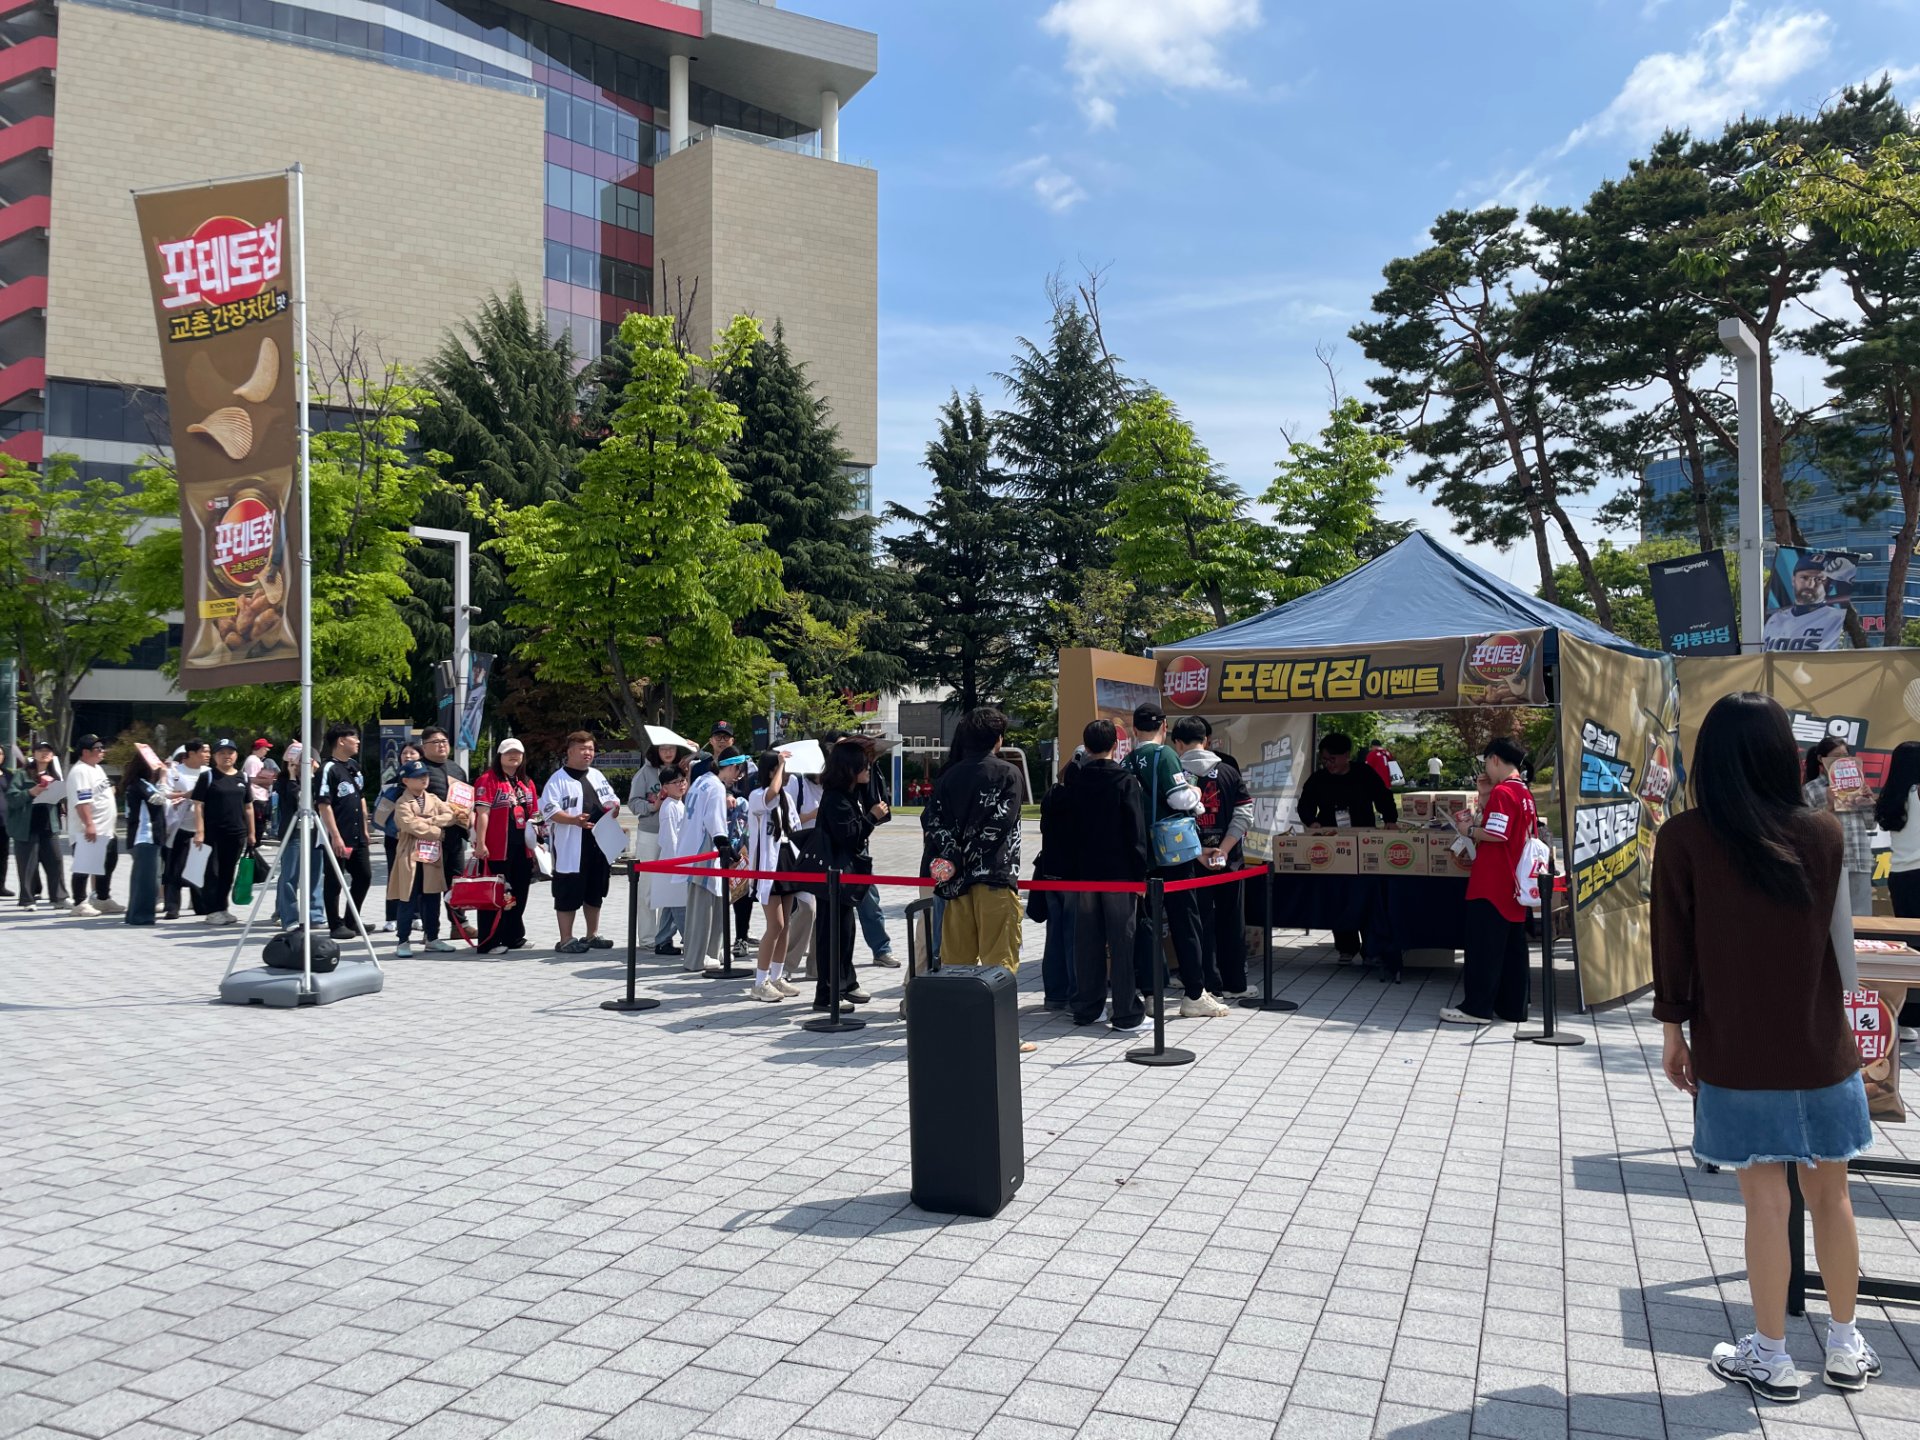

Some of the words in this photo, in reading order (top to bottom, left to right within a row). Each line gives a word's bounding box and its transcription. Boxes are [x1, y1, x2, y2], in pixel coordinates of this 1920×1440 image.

[159, 218, 282, 308] 포테토칩
[170, 310, 211, 340] 교촌
[213, 509, 276, 566] 포테토칩
[1671, 625, 1730, 650] 위풍당당
[1469, 644, 1527, 666] 포테토칩
[1163, 667, 1210, 696] 포테토칩
[1221, 659, 1366, 700] 포텐터짐
[1366, 667, 1440, 696] 이벤트
[1583, 722, 1618, 757] 오늘의
[1790, 714, 1860, 746] 늘의
[1574, 800, 1641, 866] 포테토칩
